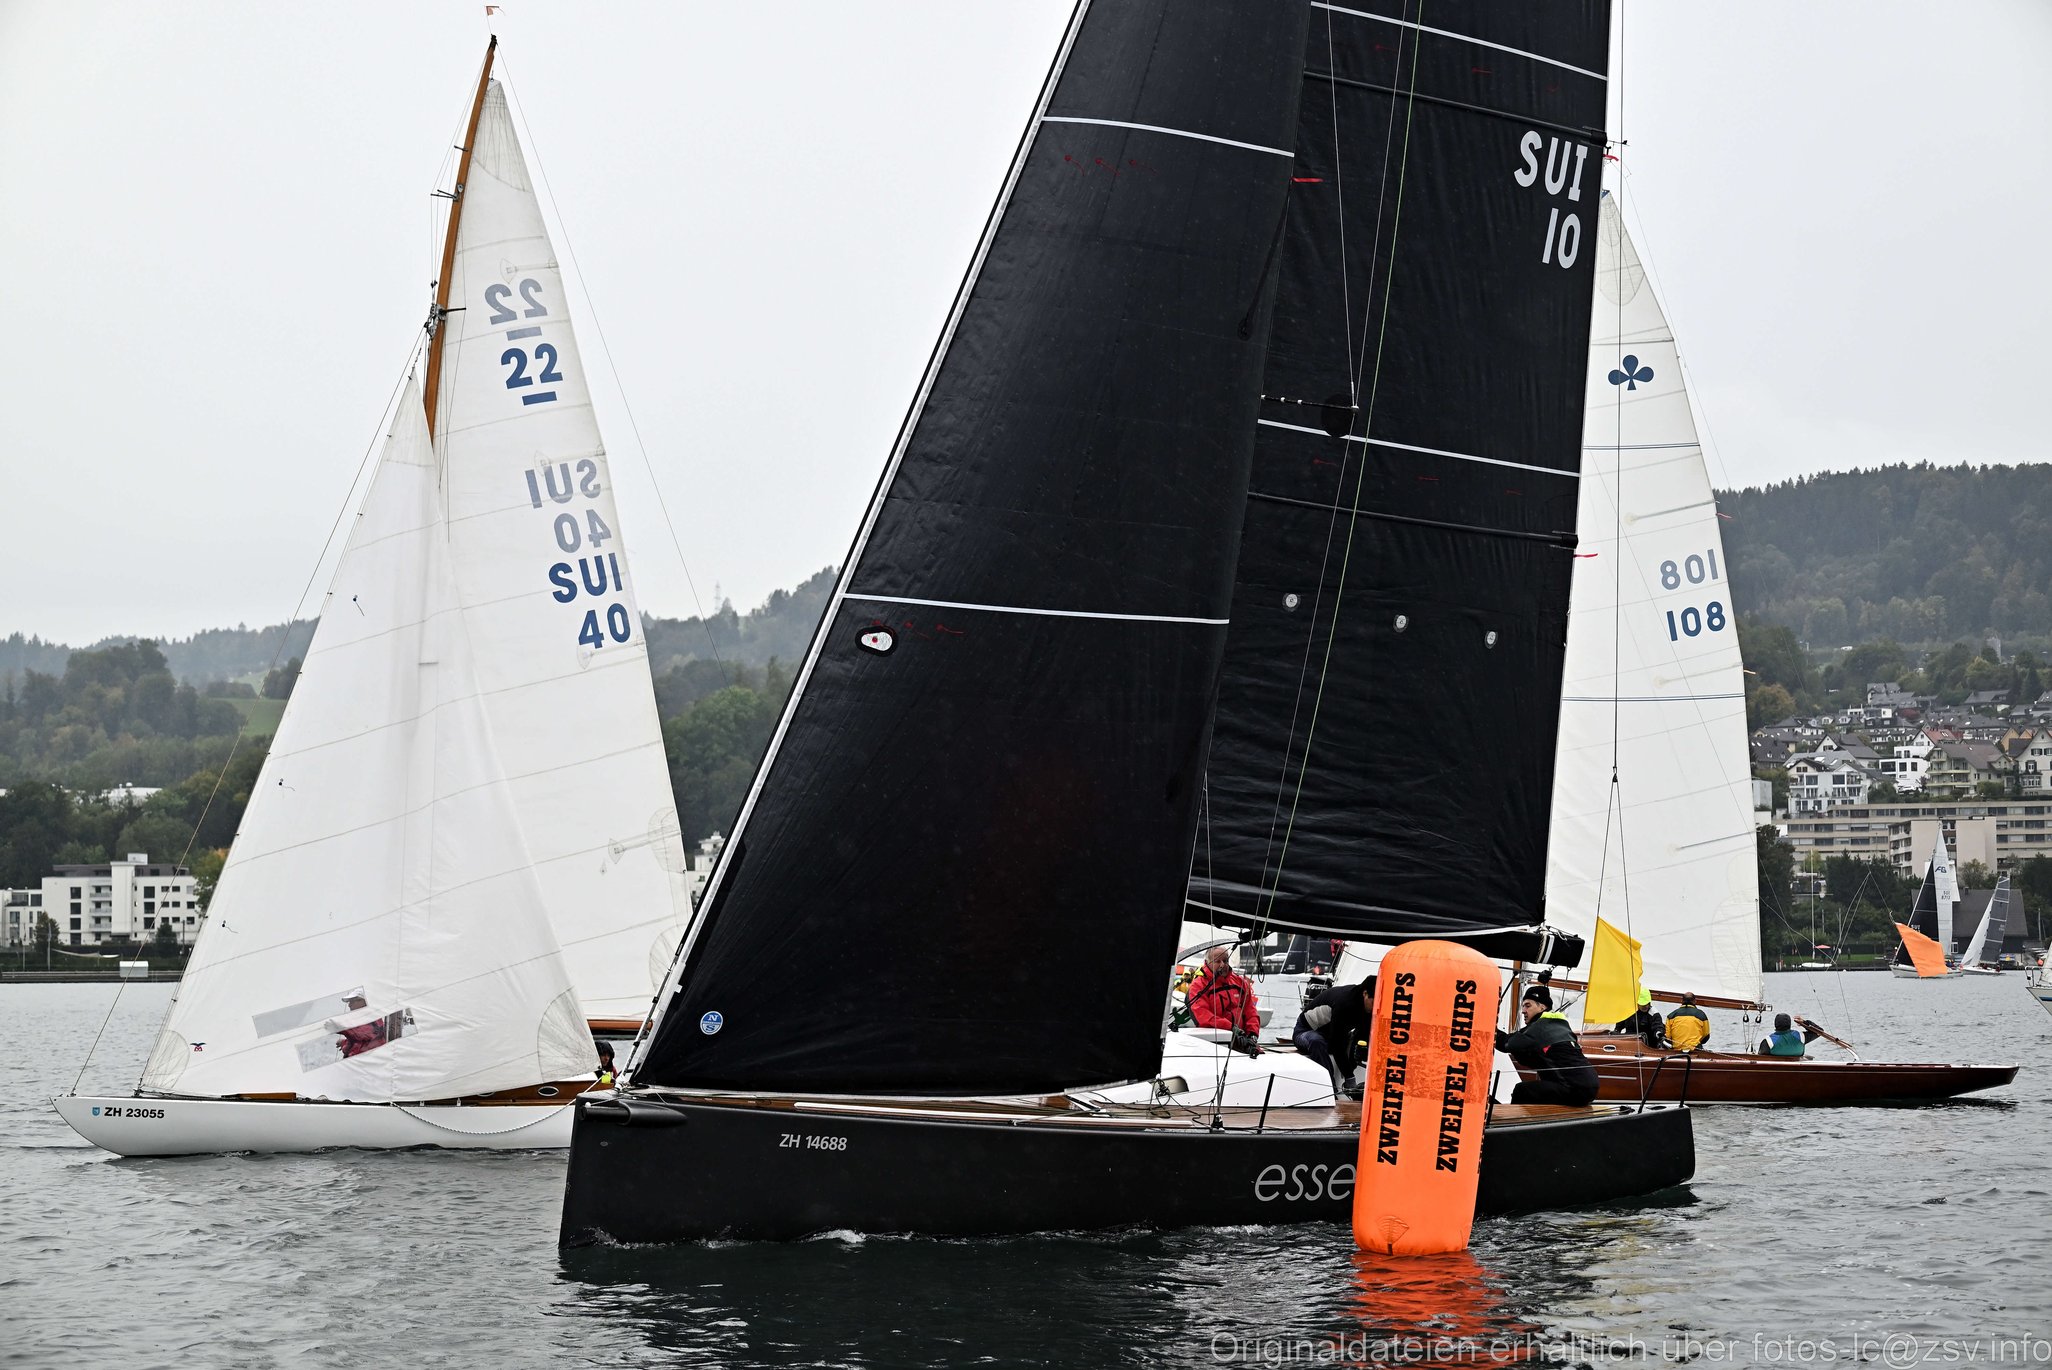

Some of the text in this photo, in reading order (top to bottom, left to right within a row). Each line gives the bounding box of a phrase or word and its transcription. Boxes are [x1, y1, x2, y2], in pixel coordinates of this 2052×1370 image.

[1513, 130, 1589, 202] SUI
[1542, 207, 1581, 269] 10
[500, 343, 563, 389] 22
[548, 552, 623, 604] SUI
[578, 603, 631, 649] 40
[1666, 601, 1726, 641] 108
[1377, 972, 1416, 1166] ZWEIFEL CHIPS
[1436, 979, 1477, 1173] ZWEIFEL CHIPS
[104, 1107, 165, 1119] ZH 23055
[779, 1133, 848, 1151] ZH 14688
[1254, 1163, 1356, 1202] esse
